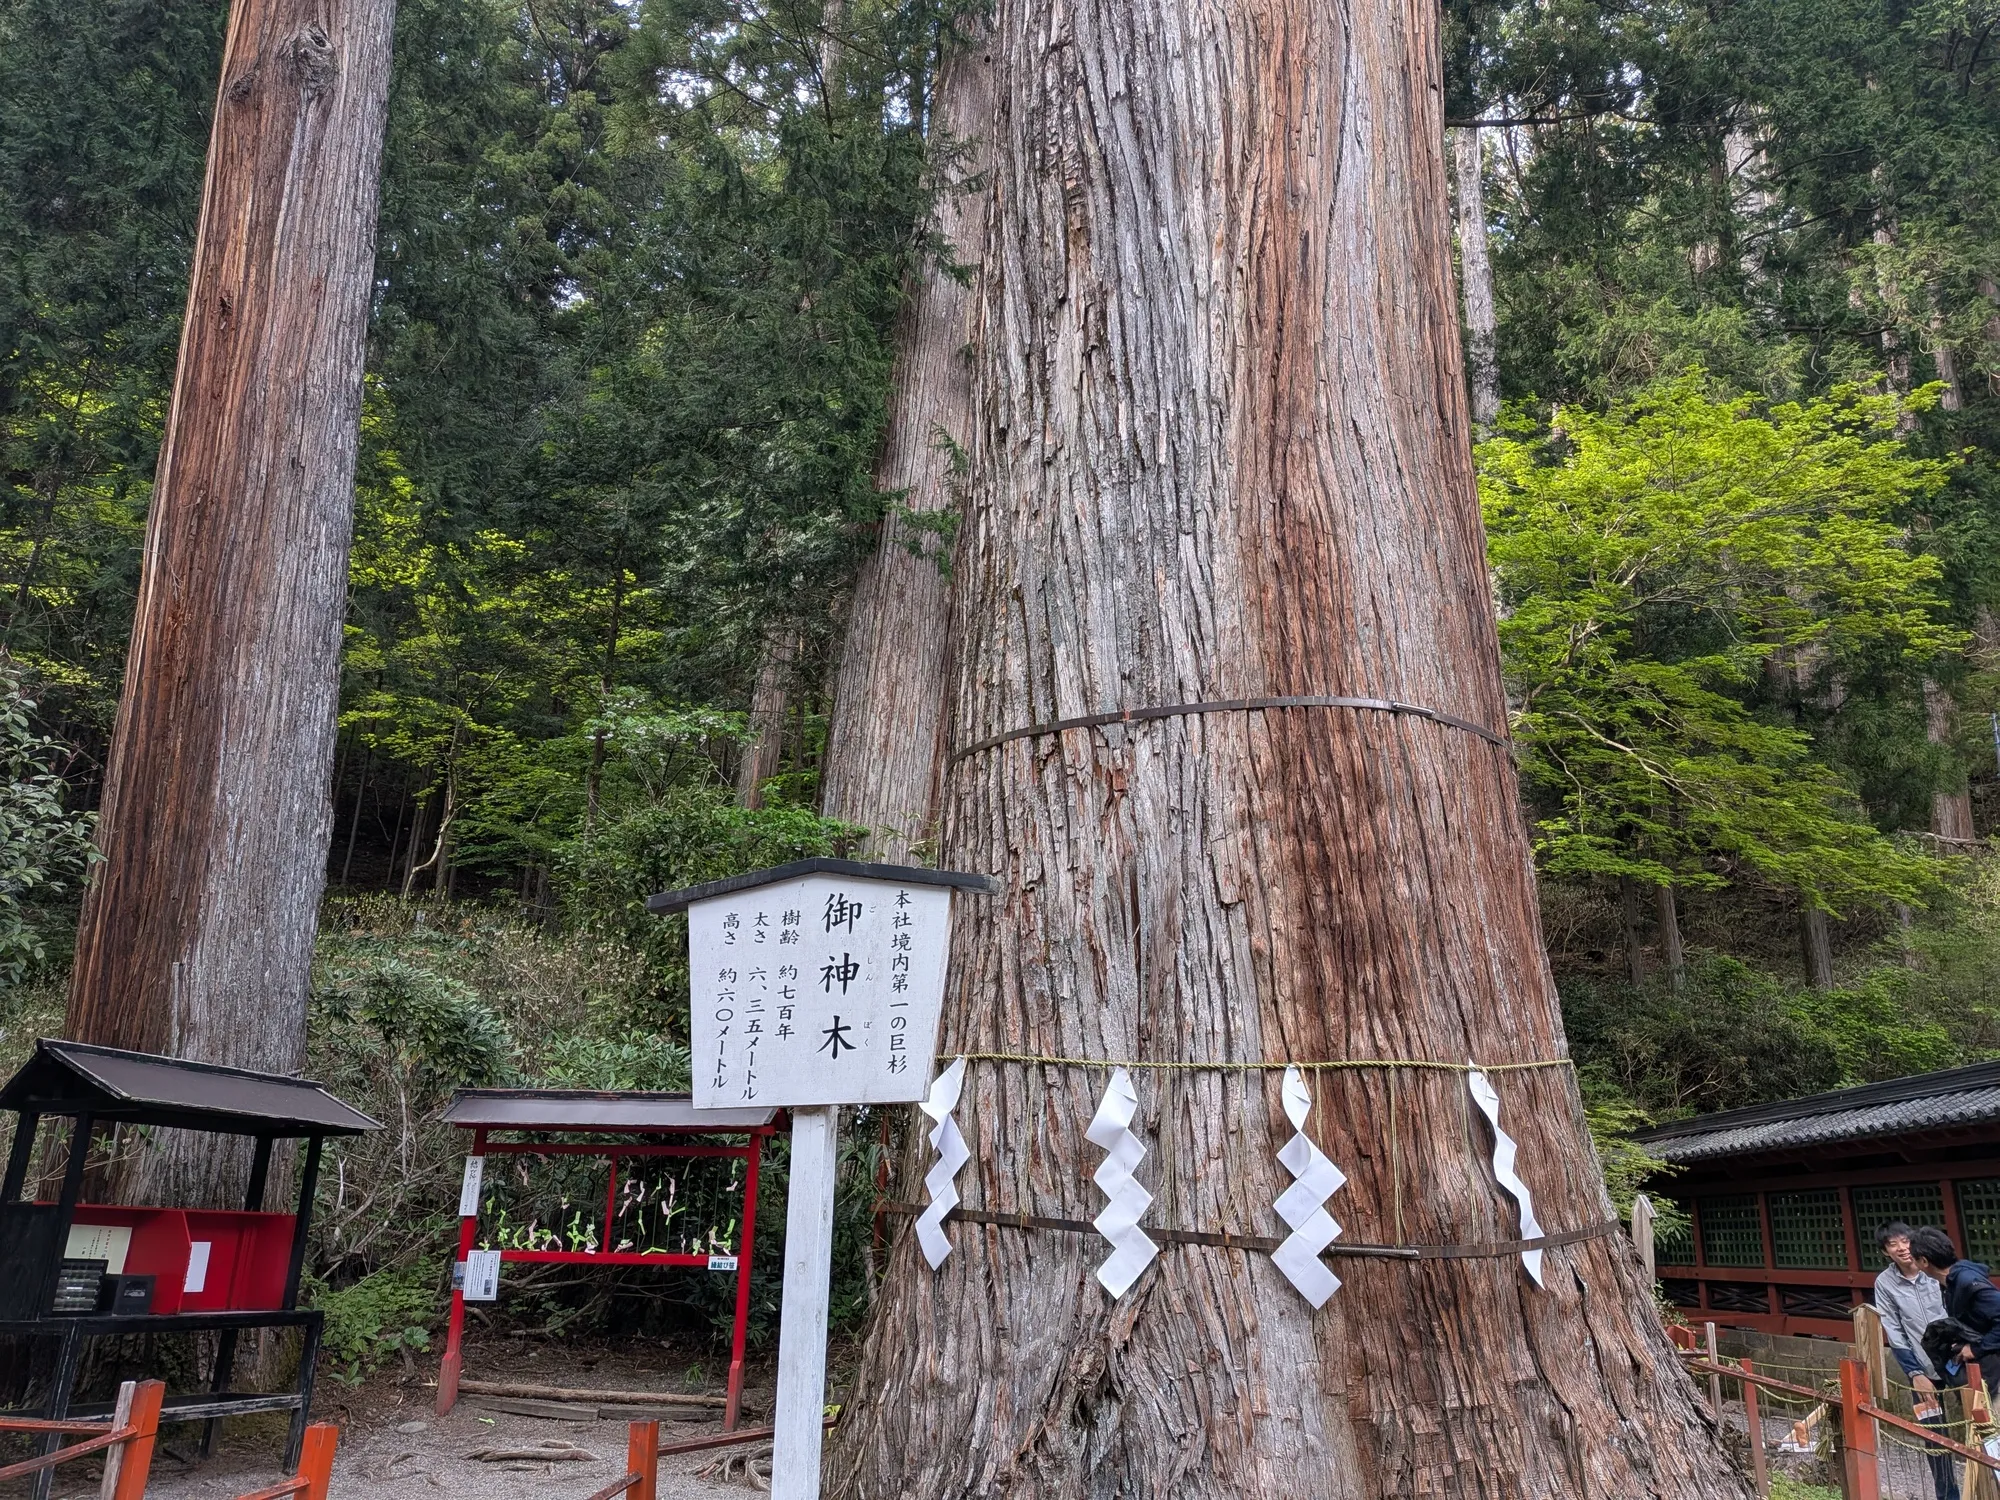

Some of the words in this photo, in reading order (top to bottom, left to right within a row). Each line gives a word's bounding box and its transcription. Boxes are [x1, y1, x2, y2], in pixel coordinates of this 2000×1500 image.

[869, 905, 877, 914] ご
[723, 912, 740, 945] 高さ
[752, 911, 770, 944] 太さ
[779, 909, 801, 945] 樹齢
[815, 892, 863, 1060] 御神木
[865, 957, 873, 982] しん
[886, 890, 912, 1075] 本社境内第一の巨杉
[774, 964, 798, 1041] 約七百年
[740, 966, 767, 1100] 六、三五メートル
[863, 1020, 872, 1047] ぼく
